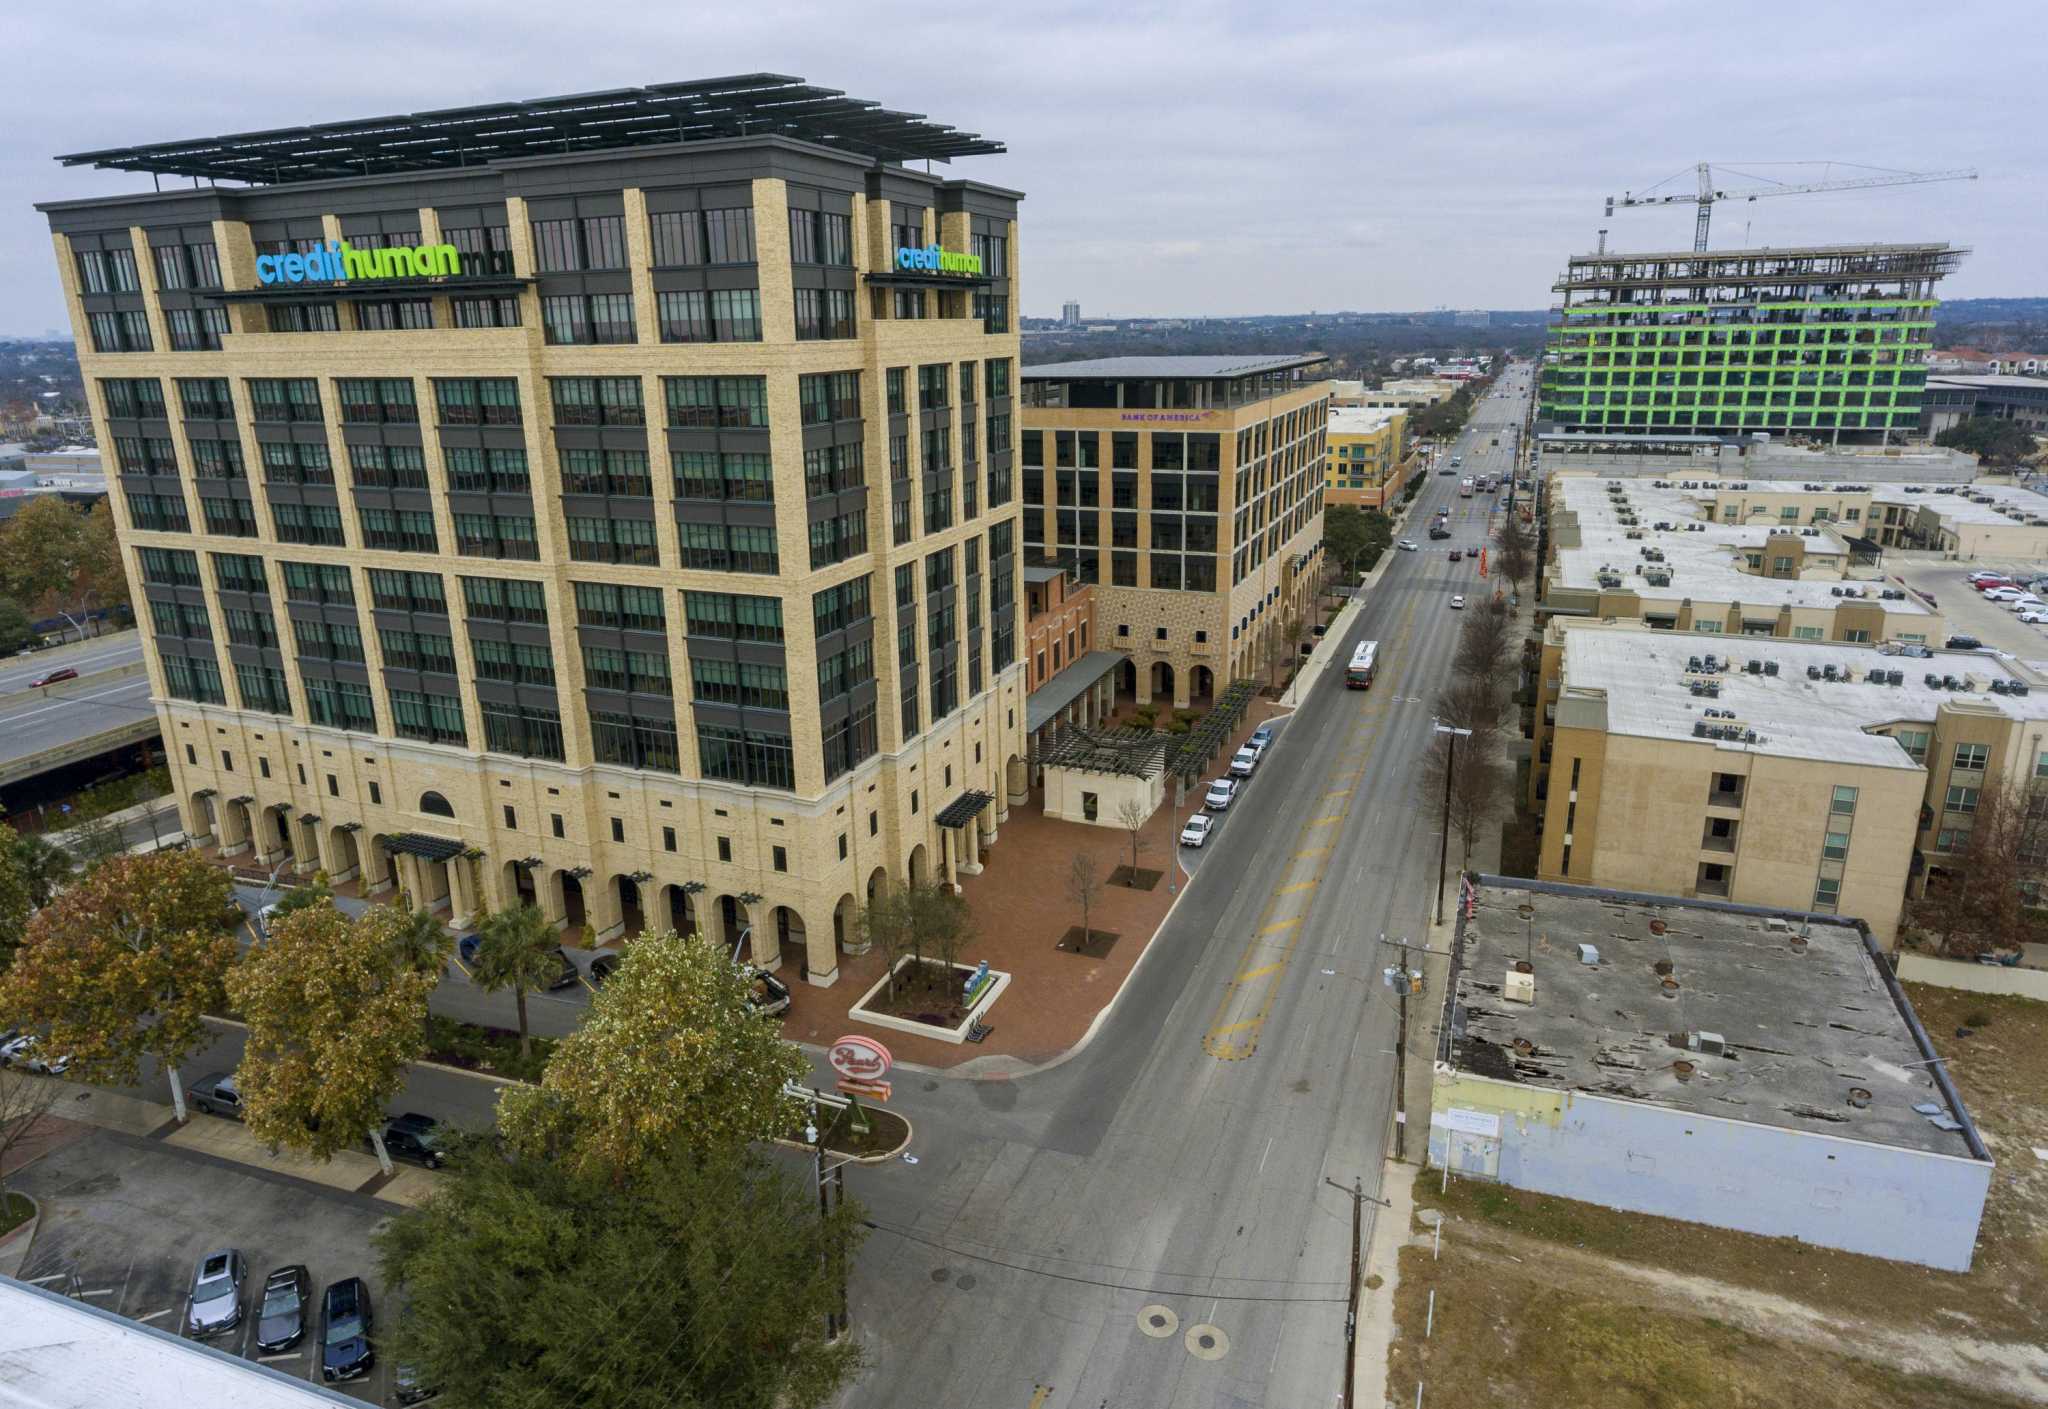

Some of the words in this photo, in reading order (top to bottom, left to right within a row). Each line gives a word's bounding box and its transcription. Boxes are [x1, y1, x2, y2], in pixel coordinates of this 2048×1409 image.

[1121, 413, 1145, 421] BANK
[1147, 413, 1158, 421] OF
[1158, 413, 1200, 421] AMERICA
